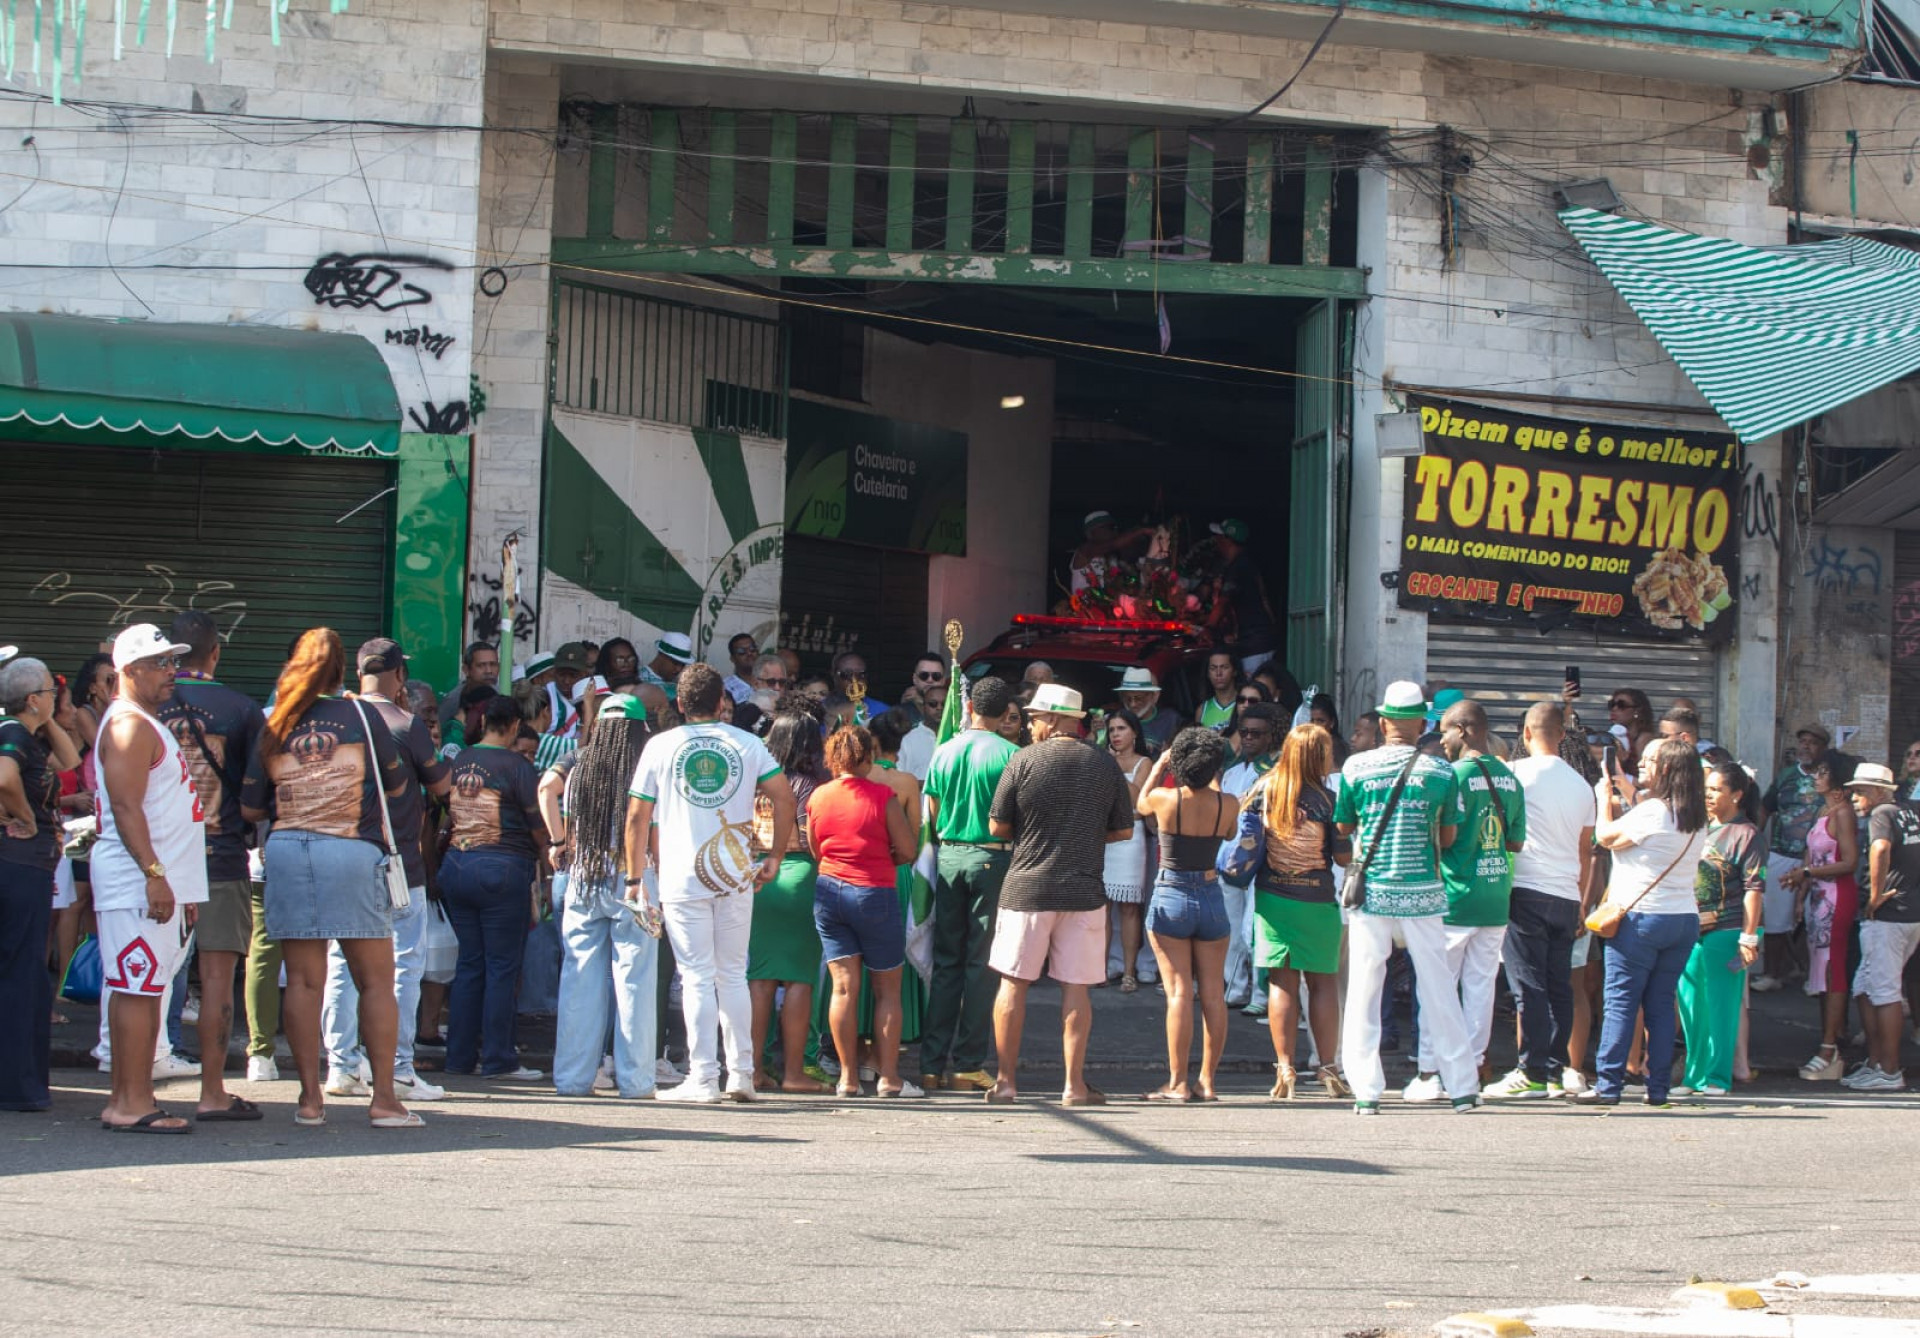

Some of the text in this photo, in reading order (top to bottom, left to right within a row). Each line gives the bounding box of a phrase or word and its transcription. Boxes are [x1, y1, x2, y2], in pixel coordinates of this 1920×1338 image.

[1420, 407, 1508, 443] Dizem
[1514, 425, 1568, 451] que
[1575, 427, 1591, 454] é
[1597, 437, 1615, 456] o
[1620, 437, 1719, 467] melhor
[854, 444, 917, 476] Chaveiro e
[854, 471, 908, 500] Cutelaria
[1414, 455, 1731, 553] TORRESMO
[1406, 535, 1631, 575] O MAIS COMENTADO DO RIO!!
[1407, 572, 1498, 605] CROCANTE
[1506, 583, 1523, 607] E
